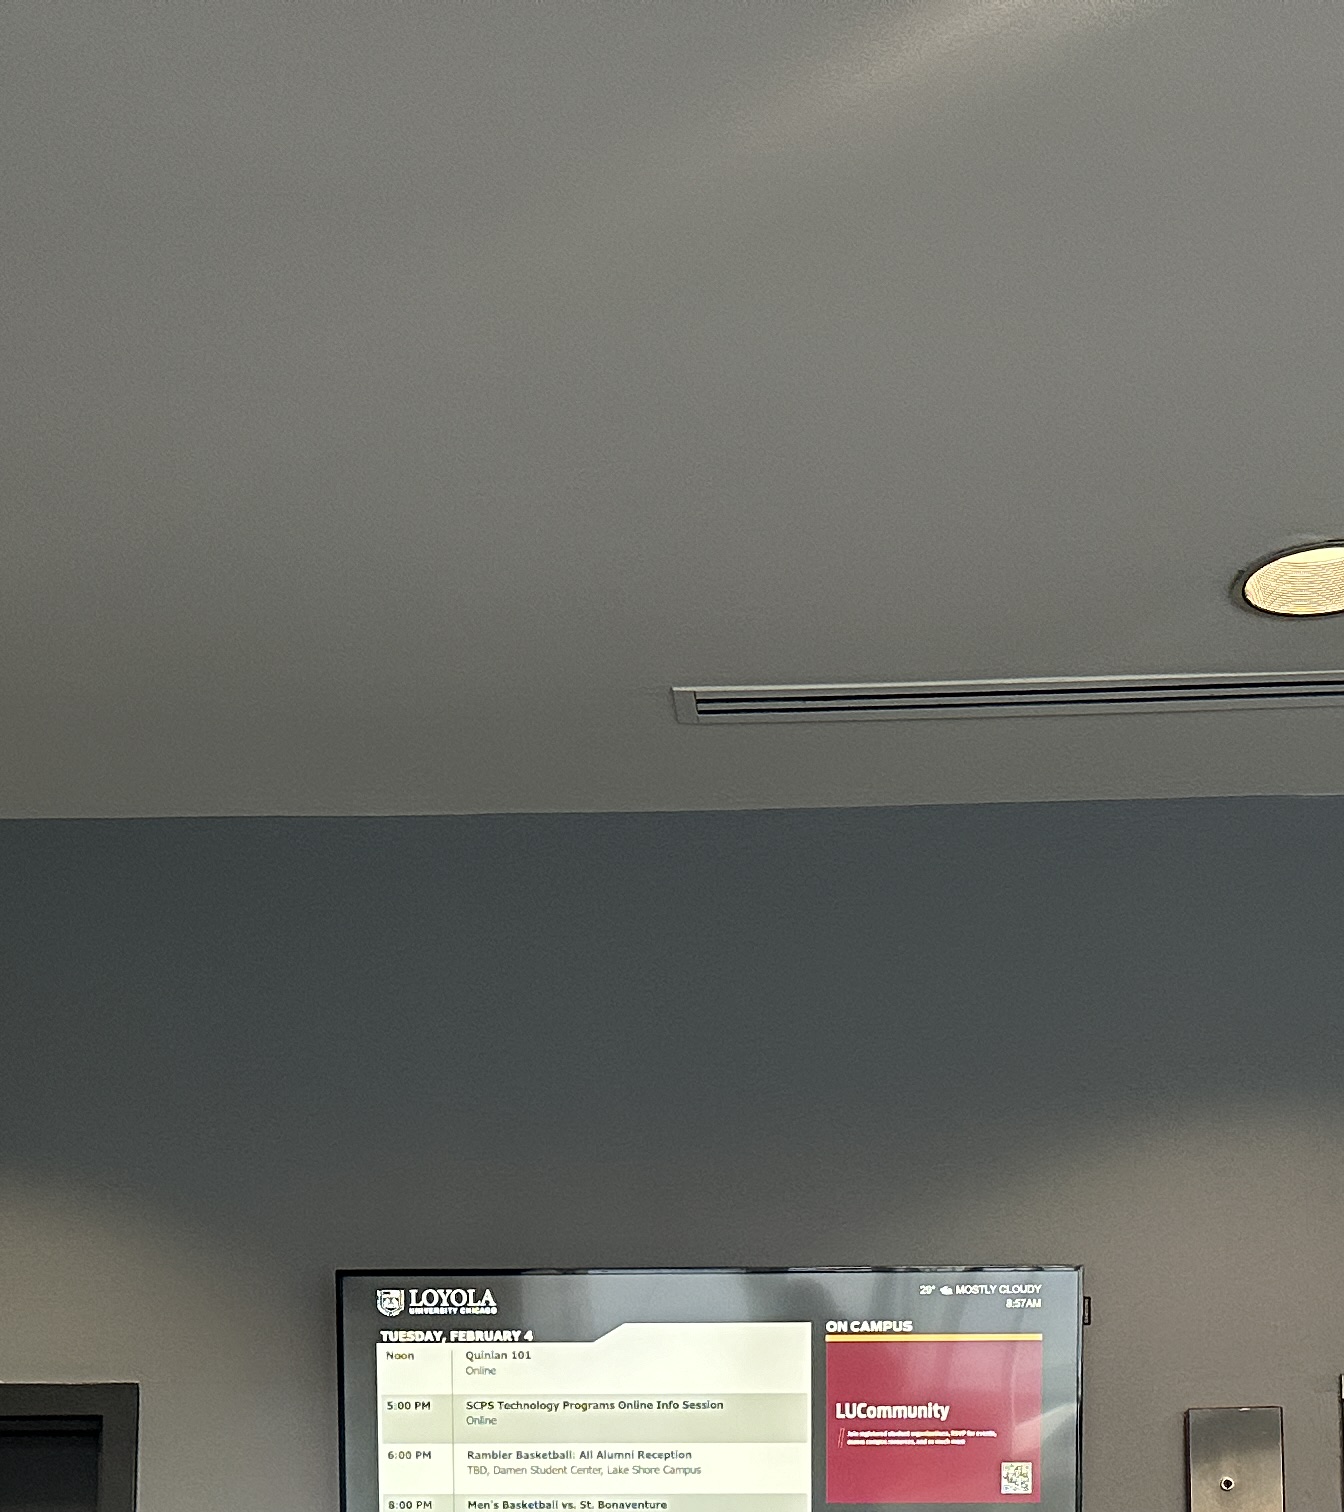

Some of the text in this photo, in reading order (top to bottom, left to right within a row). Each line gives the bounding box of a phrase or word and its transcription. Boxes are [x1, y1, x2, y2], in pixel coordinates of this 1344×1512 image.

[955, 1284, 997, 1295] MOSTLY
[998, 1283, 1042, 1294] CLOUDY
[408, 1288, 497, 1307] LOYOLA
[408, 1306, 498, 1315] UNIVERSITY CHICAGO
[825, 1320, 913, 1332] ON CAMPUS
[380, 1330, 534, 1343] TUESDAY, FEBRUARY 4
[386, 1350, 415, 1360] Noon
[511, 1350, 532, 1360] 101
[465, 1366, 497, 1376] Online
[386, 1401, 431, 1411] 5:00 PM
[465, 1400, 724, 1412] SCPS Technology Programs Online Info Session
[835, 1402, 950, 1421] LUCommunity
[465, 1415, 498, 1426] Online
[387, 1450, 432, 1460] 6:00 PM
[467, 1449, 692, 1462] Rambler Basketball: All Alumni Reception
[467, 1464, 702, 1476] TBD, Damen Student Center, Lake Shore Campus
[388, 1500, 433, 1510] 8:00 PM
[467, 1499, 668, 1510] Men's Basketball vs. St. Bonaventure
